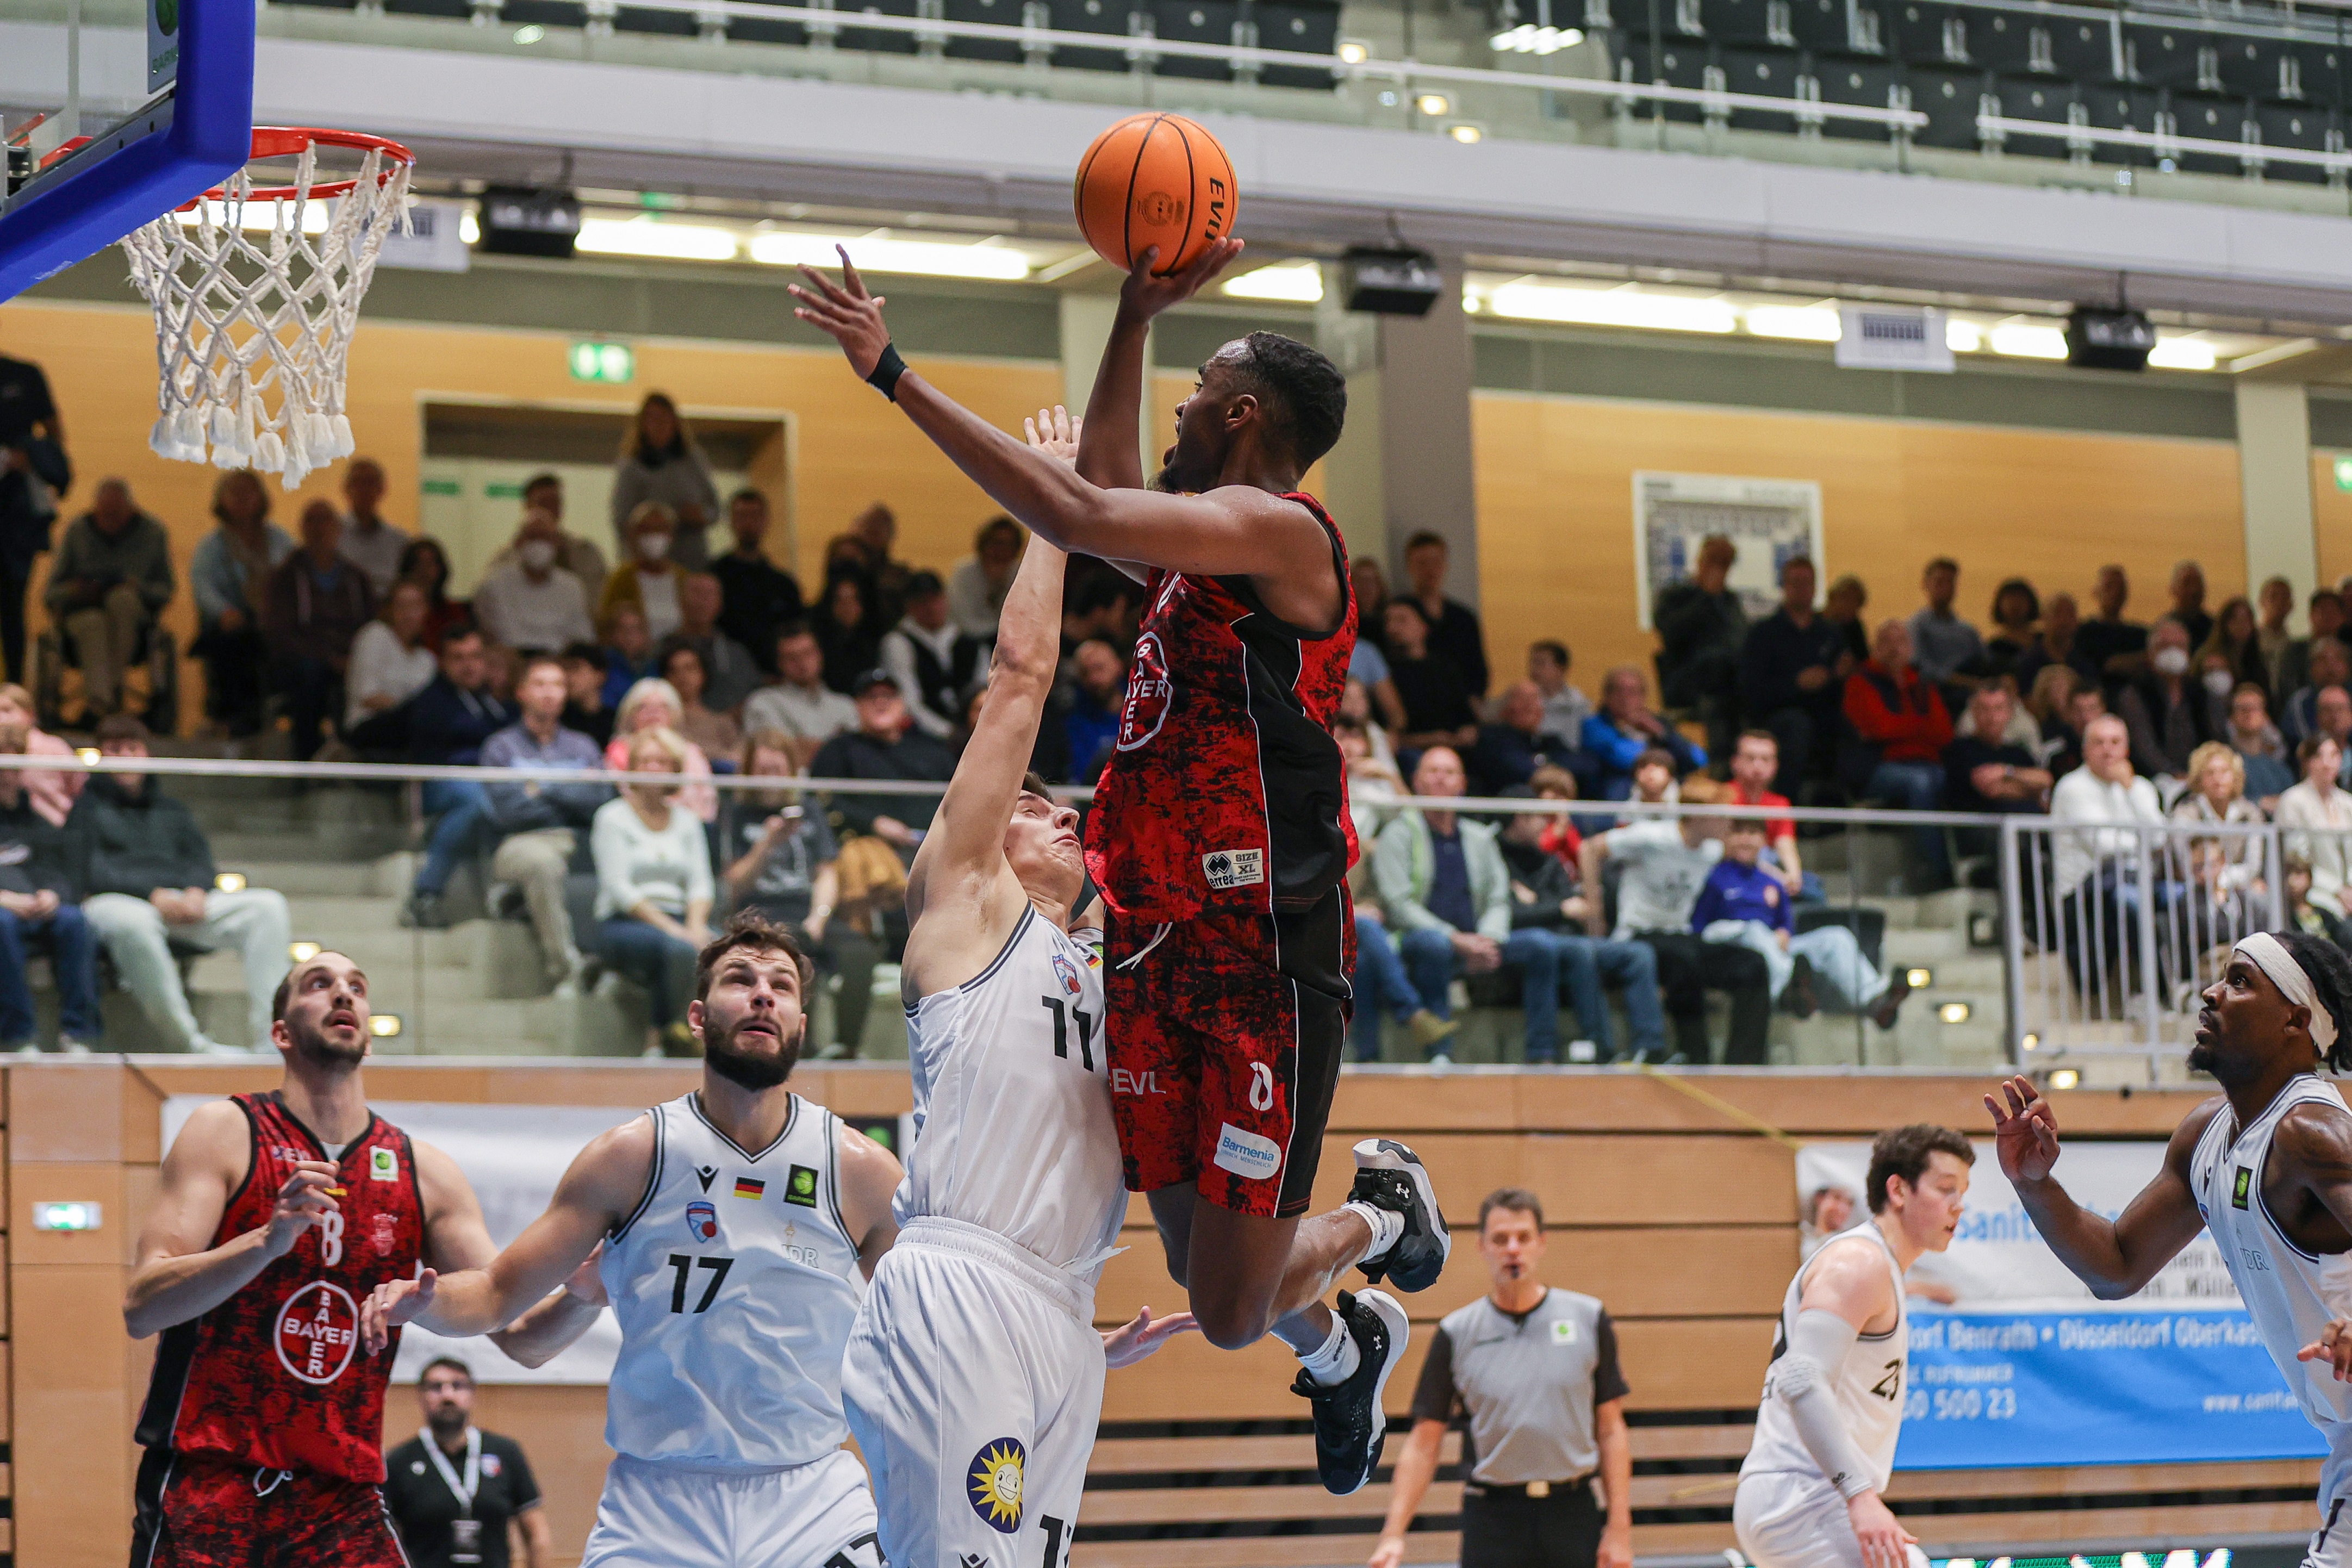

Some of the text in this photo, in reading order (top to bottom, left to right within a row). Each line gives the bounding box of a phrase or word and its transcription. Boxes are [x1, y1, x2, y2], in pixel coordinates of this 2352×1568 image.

[1125, 681, 1166, 701] AYER
[1235, 851, 1259, 862] SIZE
[1238, 863, 1256, 875] XL
[1042, 995, 1094, 1073] 11
[1112, 1068, 1167, 1095] EVL
[1222, 1135, 1274, 1161] Barmenia
[321, 1210, 345, 1267] 8
[668, 1254, 735, 1314] 17
[1948, 1320, 2038, 1353] Benrath
[2058, 1316, 2170, 1351] Düsseldorf
[1987, 1387, 2016, 1420] 23
